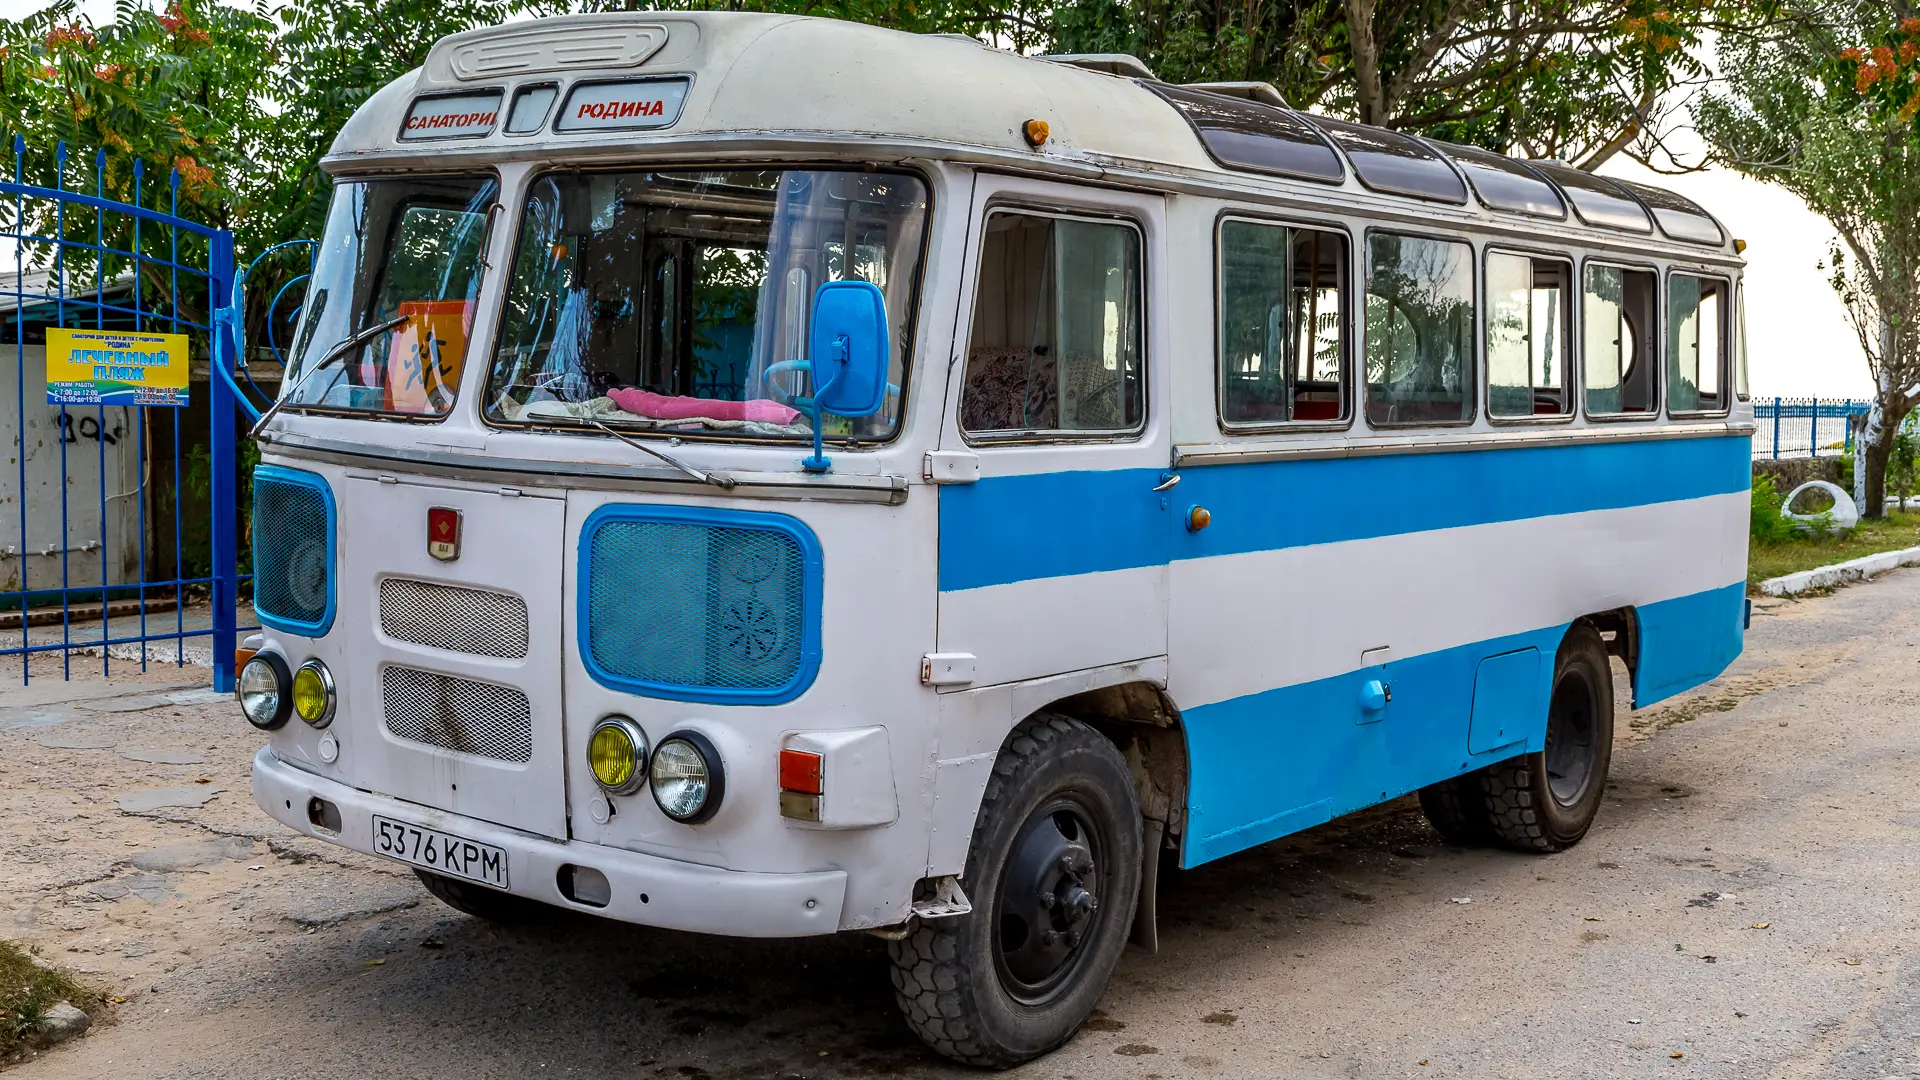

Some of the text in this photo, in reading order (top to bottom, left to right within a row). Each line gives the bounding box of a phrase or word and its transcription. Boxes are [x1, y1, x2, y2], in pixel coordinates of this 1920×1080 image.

[577, 99, 664, 120] РОДИНА
[104, 341, 135, 349] "РОДИНА"
[67, 349, 170, 367] ЛЕЧЕБНЫЙ
[93, 365, 146, 381] ПЛЯЖ
[380, 820, 501, 883] 5376 КРМ
